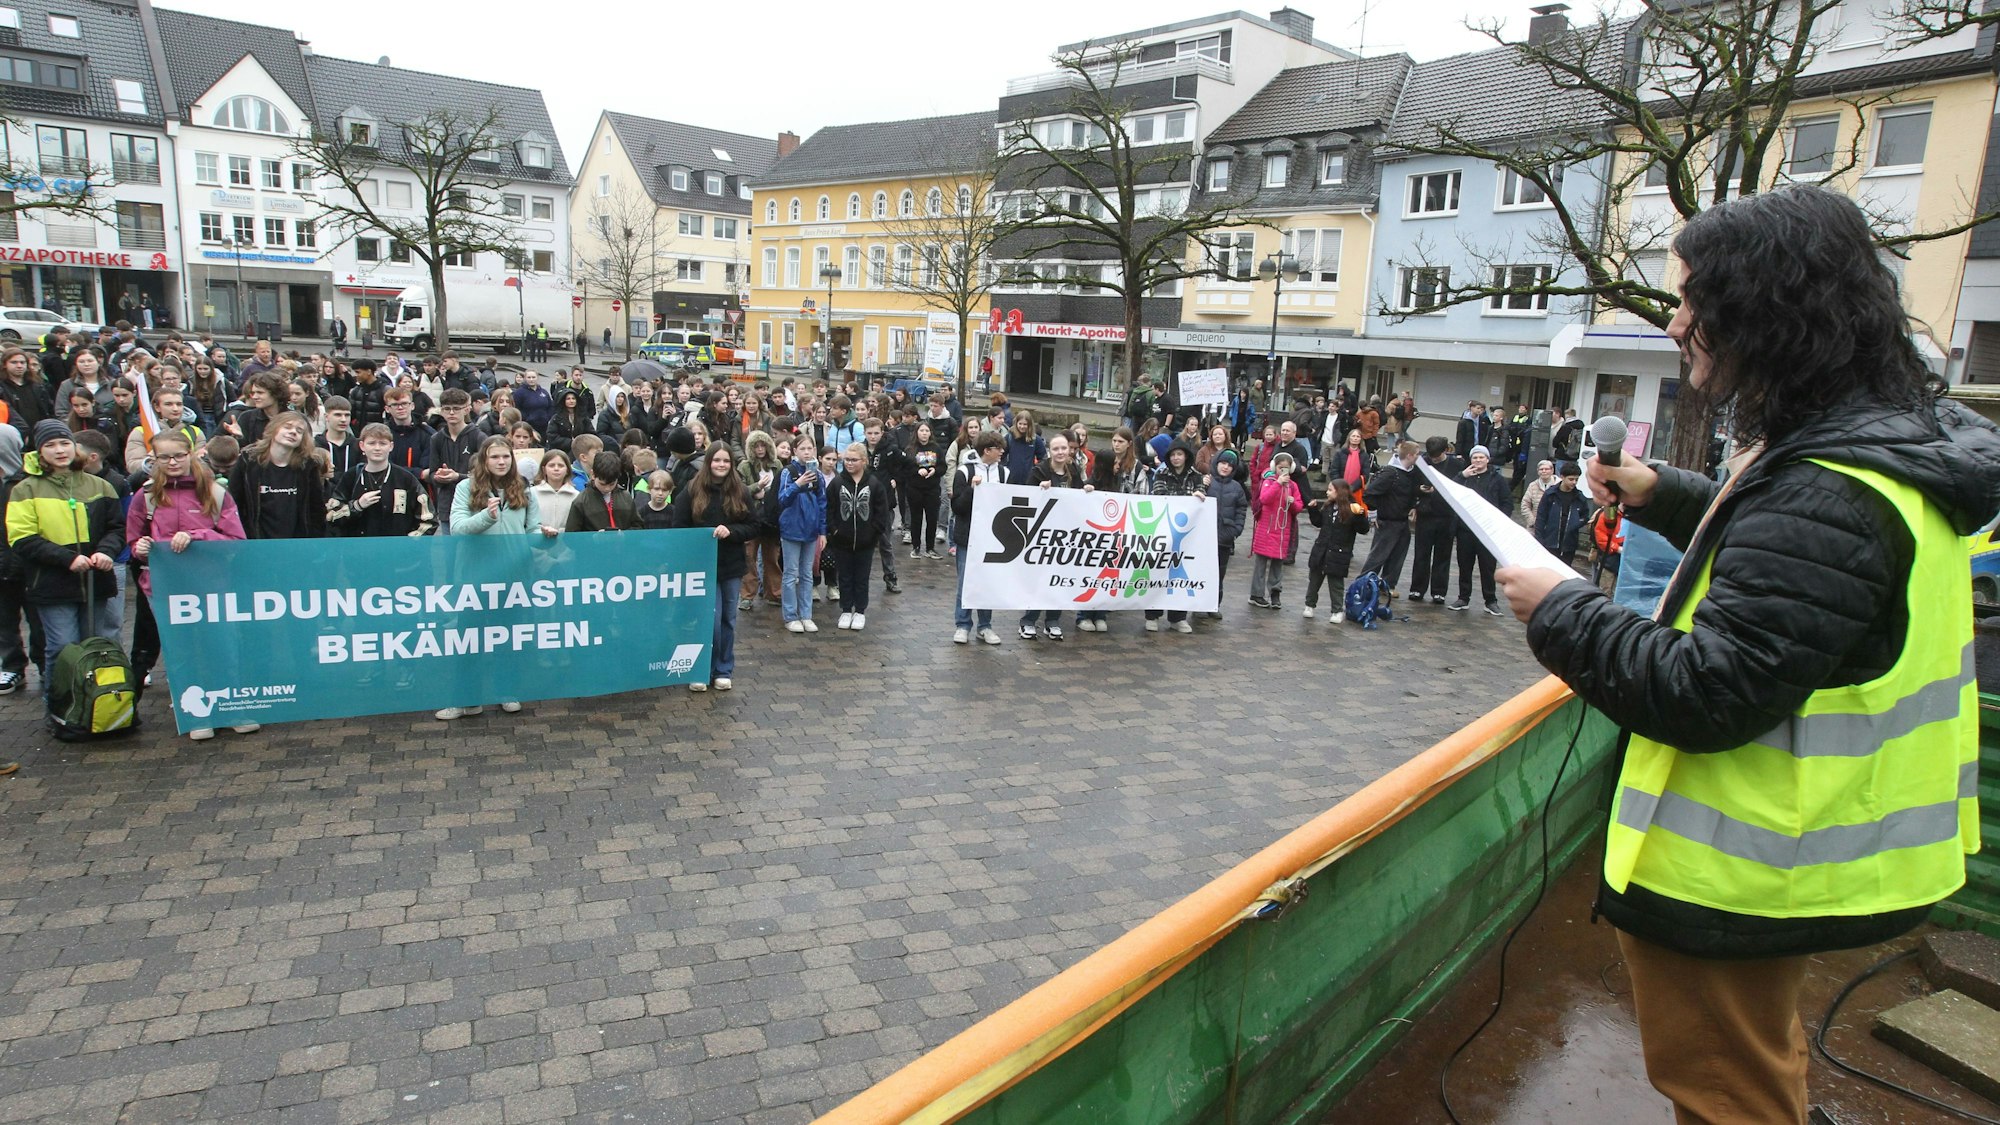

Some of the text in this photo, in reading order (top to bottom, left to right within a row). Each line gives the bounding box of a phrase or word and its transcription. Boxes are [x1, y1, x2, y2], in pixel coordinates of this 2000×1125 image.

[270, 200, 298, 210] Limbach
[802, 296, 816, 308] dm
[1036, 324, 1126, 340] Markt-Apothe
[1186, 332, 1226, 345] pequeno
[168, 571, 706, 625] BILDUNGSKATASTROPHE
[317, 620, 603, 664] BEKÄMPFEN.
[671, 658, 692, 668] DGB
[233, 684, 297, 698] LSV NRW
[218, 704, 272, 712] Nordrhein-Westfalen
